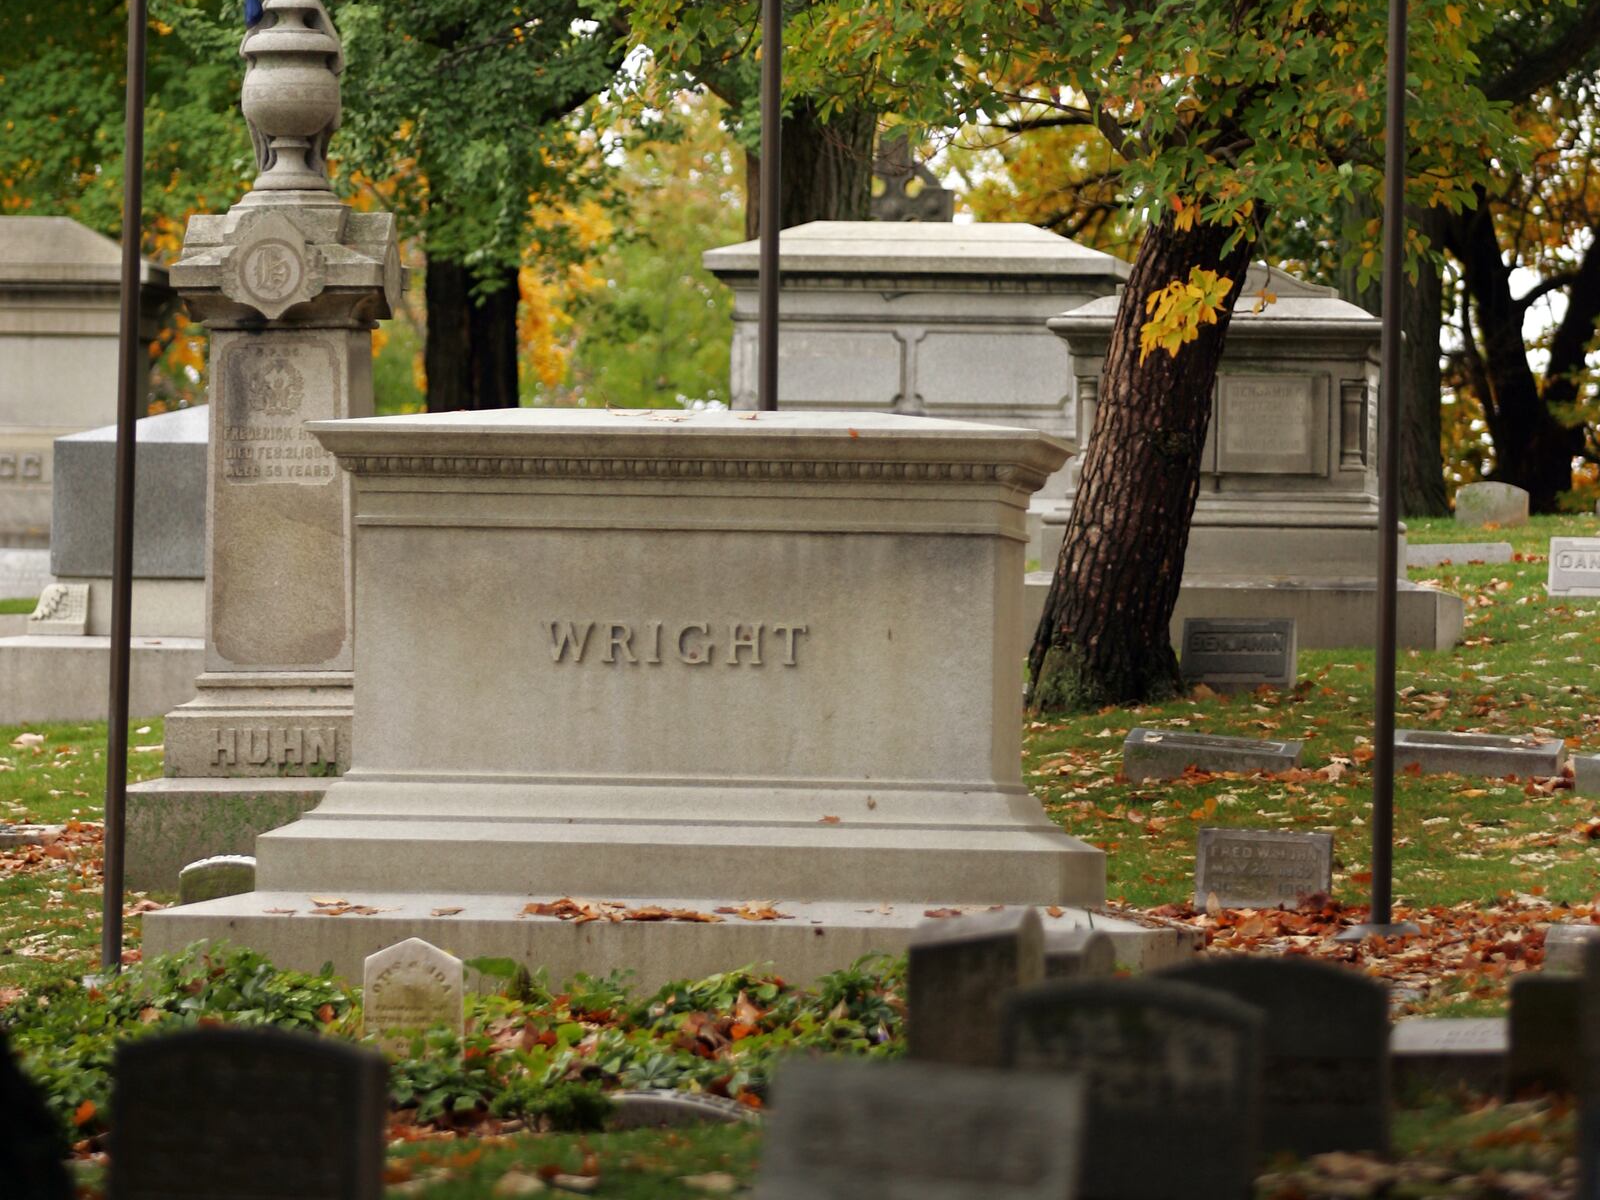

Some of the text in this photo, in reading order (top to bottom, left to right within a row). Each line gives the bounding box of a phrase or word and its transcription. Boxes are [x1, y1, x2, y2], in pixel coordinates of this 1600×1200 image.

[543, 620, 808, 667] WRIGHT
[1191, 634, 1284, 652] BENJAMIN
[210, 727, 337, 766] HUHN
